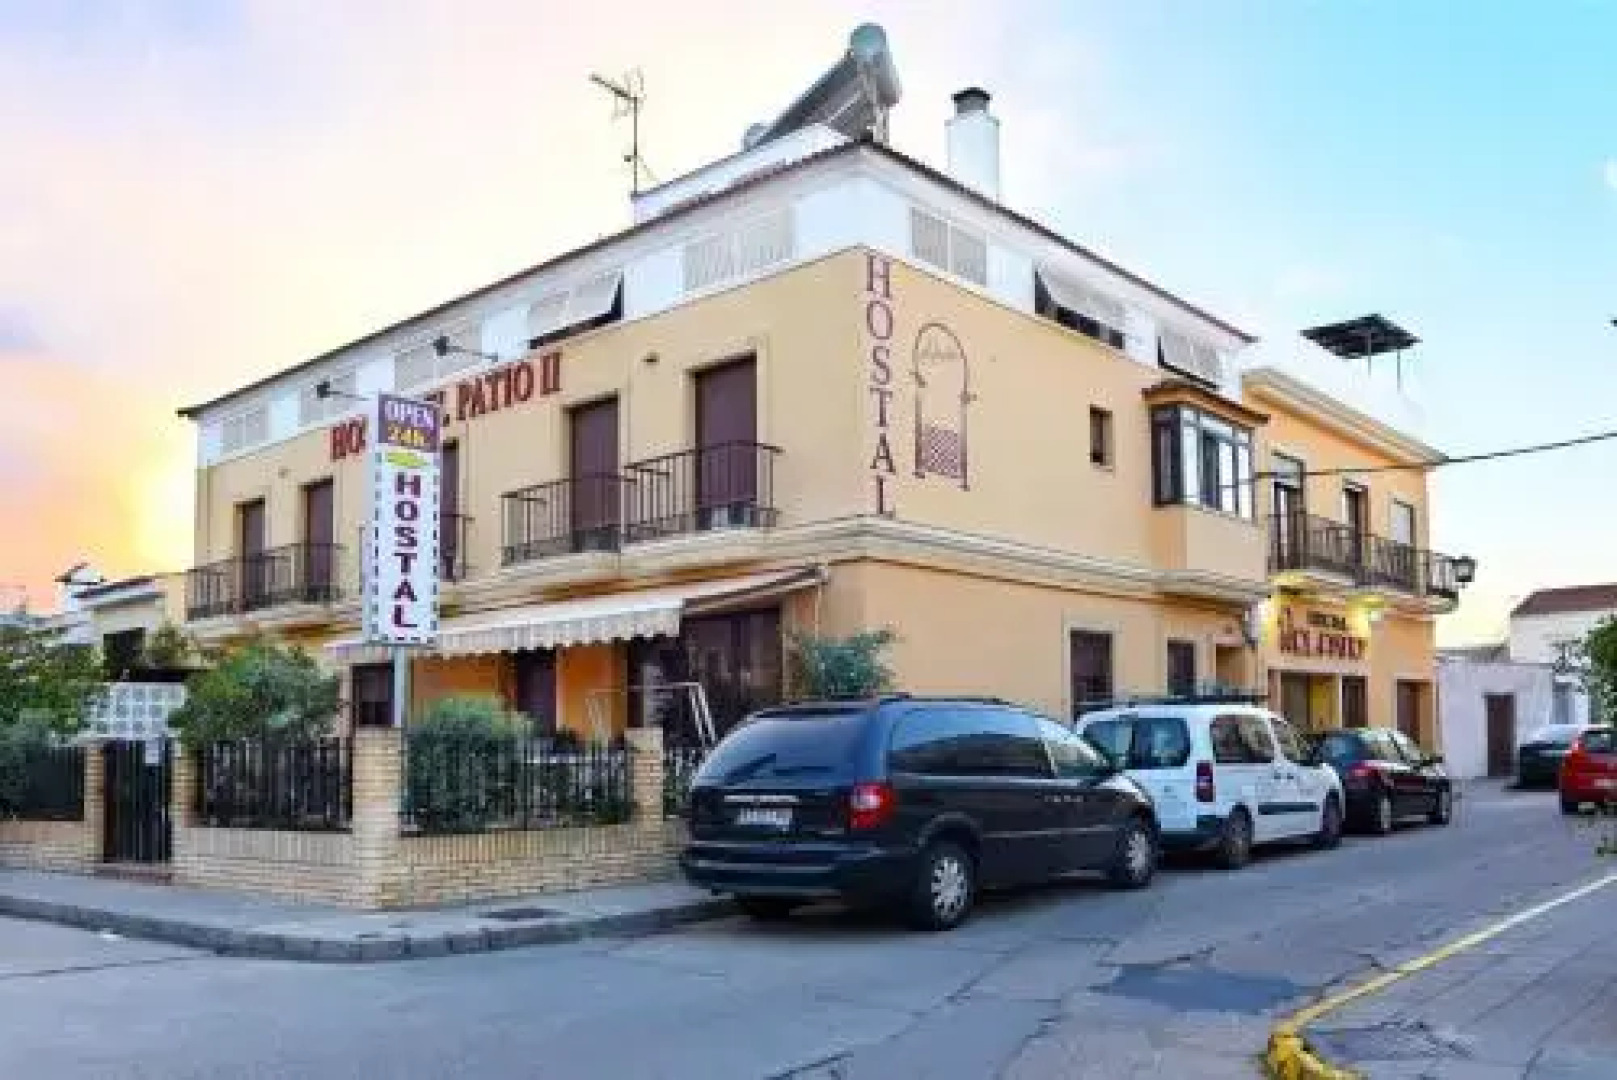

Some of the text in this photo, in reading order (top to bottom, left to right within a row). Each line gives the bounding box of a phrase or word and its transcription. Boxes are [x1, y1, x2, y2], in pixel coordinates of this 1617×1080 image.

[384, 400, 434, 430] OPEN
[456, 361, 534, 420] PATIO
[540, 351, 562, 395] II
[866, 255, 896, 517] HOSTAL
[393, 471, 421, 628] HOSTAL
